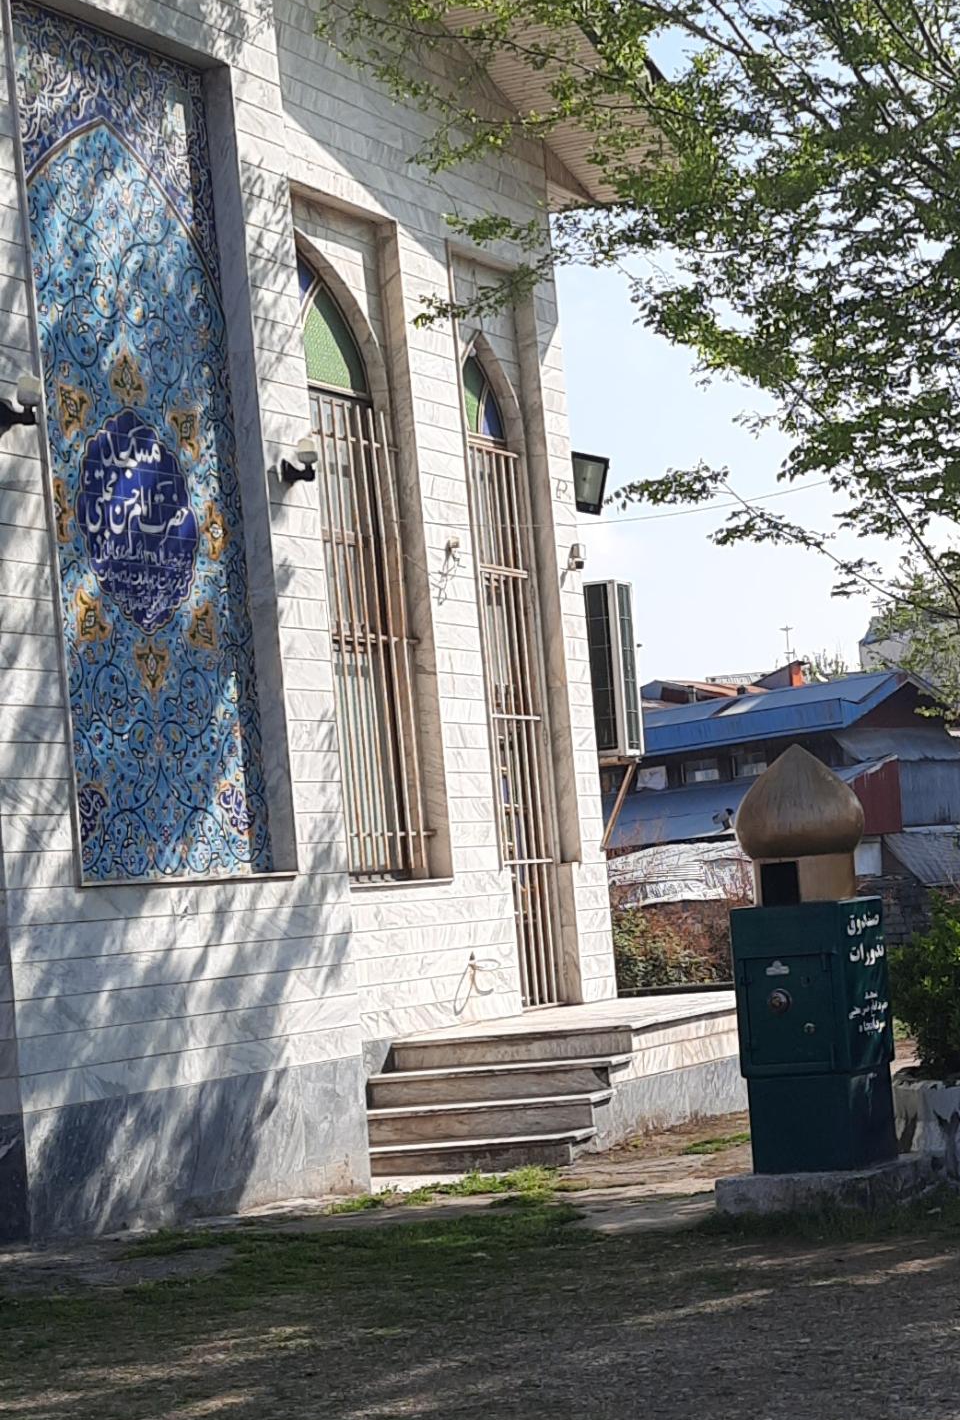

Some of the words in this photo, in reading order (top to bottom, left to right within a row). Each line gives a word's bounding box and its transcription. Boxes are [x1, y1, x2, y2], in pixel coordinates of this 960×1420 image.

[99, 425, 161, 479] مسجد
[85, 471, 117, 543] مجتبی
[109, 488, 141, 535] حسن
[138, 480, 190, 545] حضرت
[847, 911, 880, 936] صندوق
[849, 936, 885, 966] نذورات
